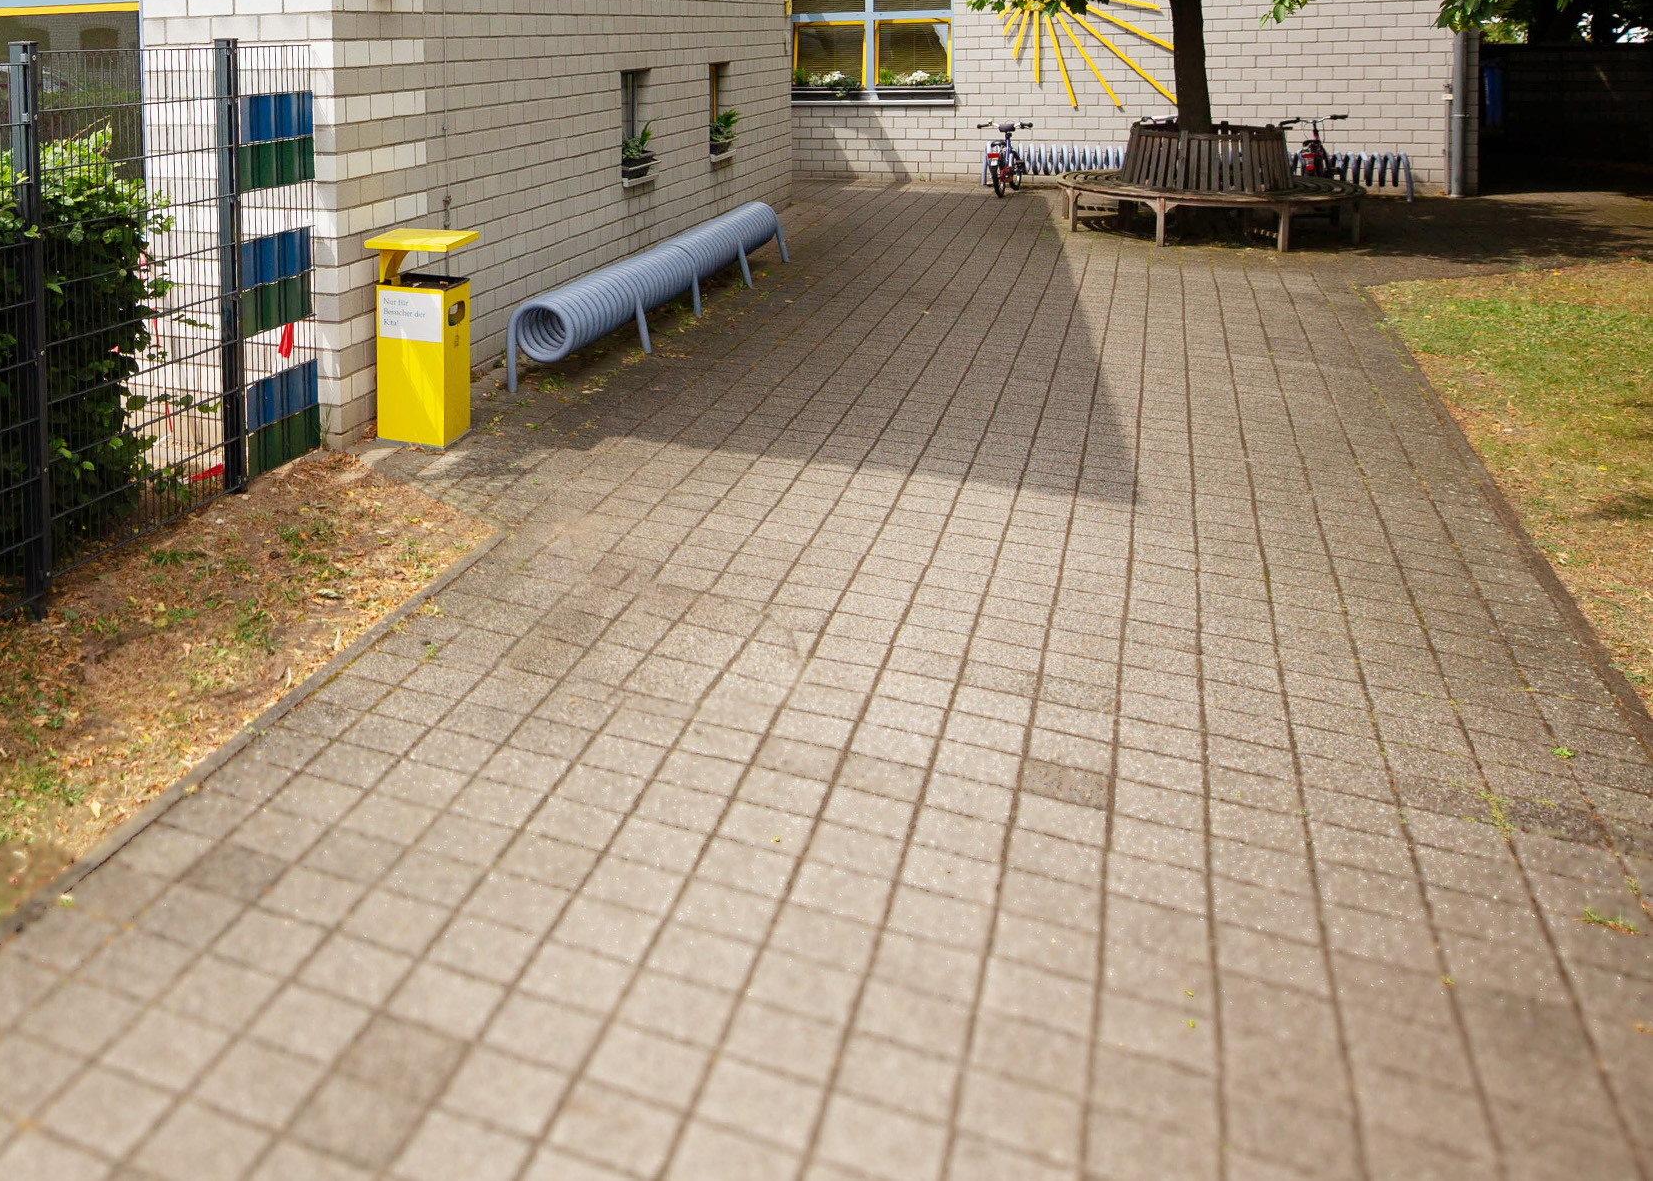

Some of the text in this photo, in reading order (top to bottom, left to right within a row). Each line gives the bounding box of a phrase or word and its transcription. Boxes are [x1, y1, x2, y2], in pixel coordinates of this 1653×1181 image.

[383, 297, 409, 306] Nur für
[383, 307, 426, 318] Besucher der
